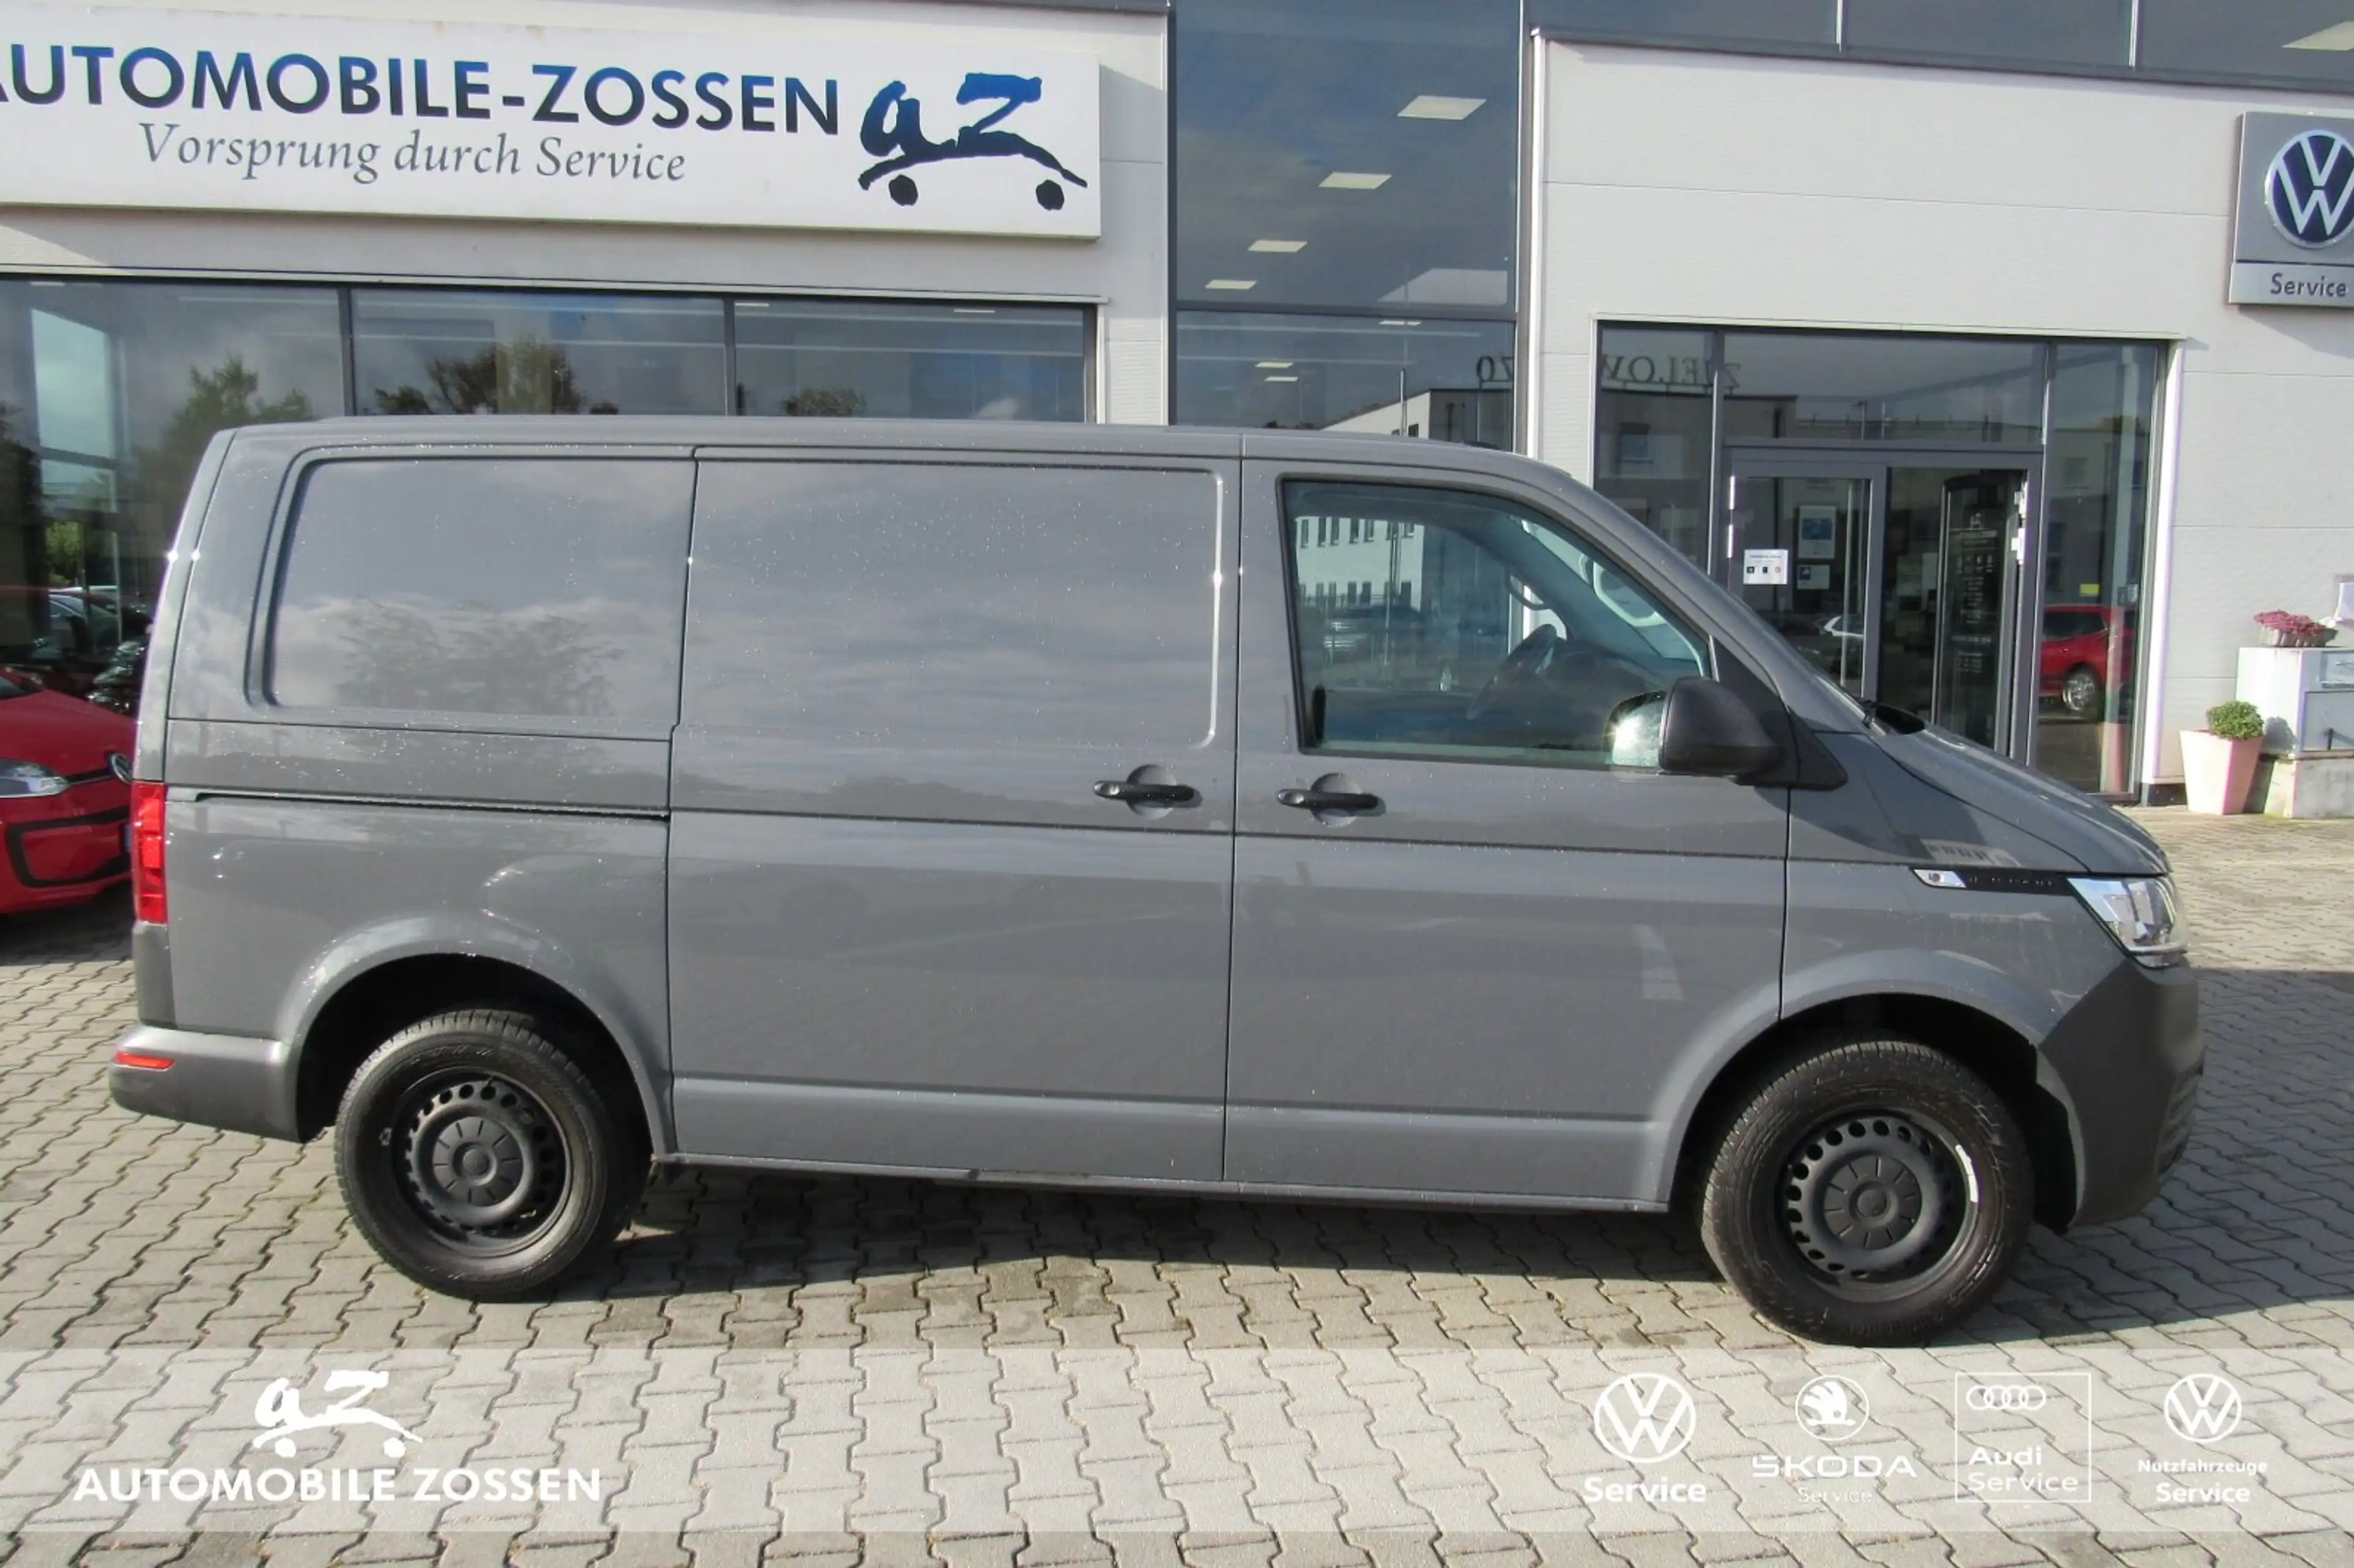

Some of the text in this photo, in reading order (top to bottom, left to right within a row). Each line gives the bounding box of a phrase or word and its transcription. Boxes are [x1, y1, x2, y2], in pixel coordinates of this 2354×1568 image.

[0, 43, 839, 135] UTOMOBILE-ZOSSEN
[139, 123, 686, 185] Vorsprung durch Service
[2270, 273, 2347, 297] Service
